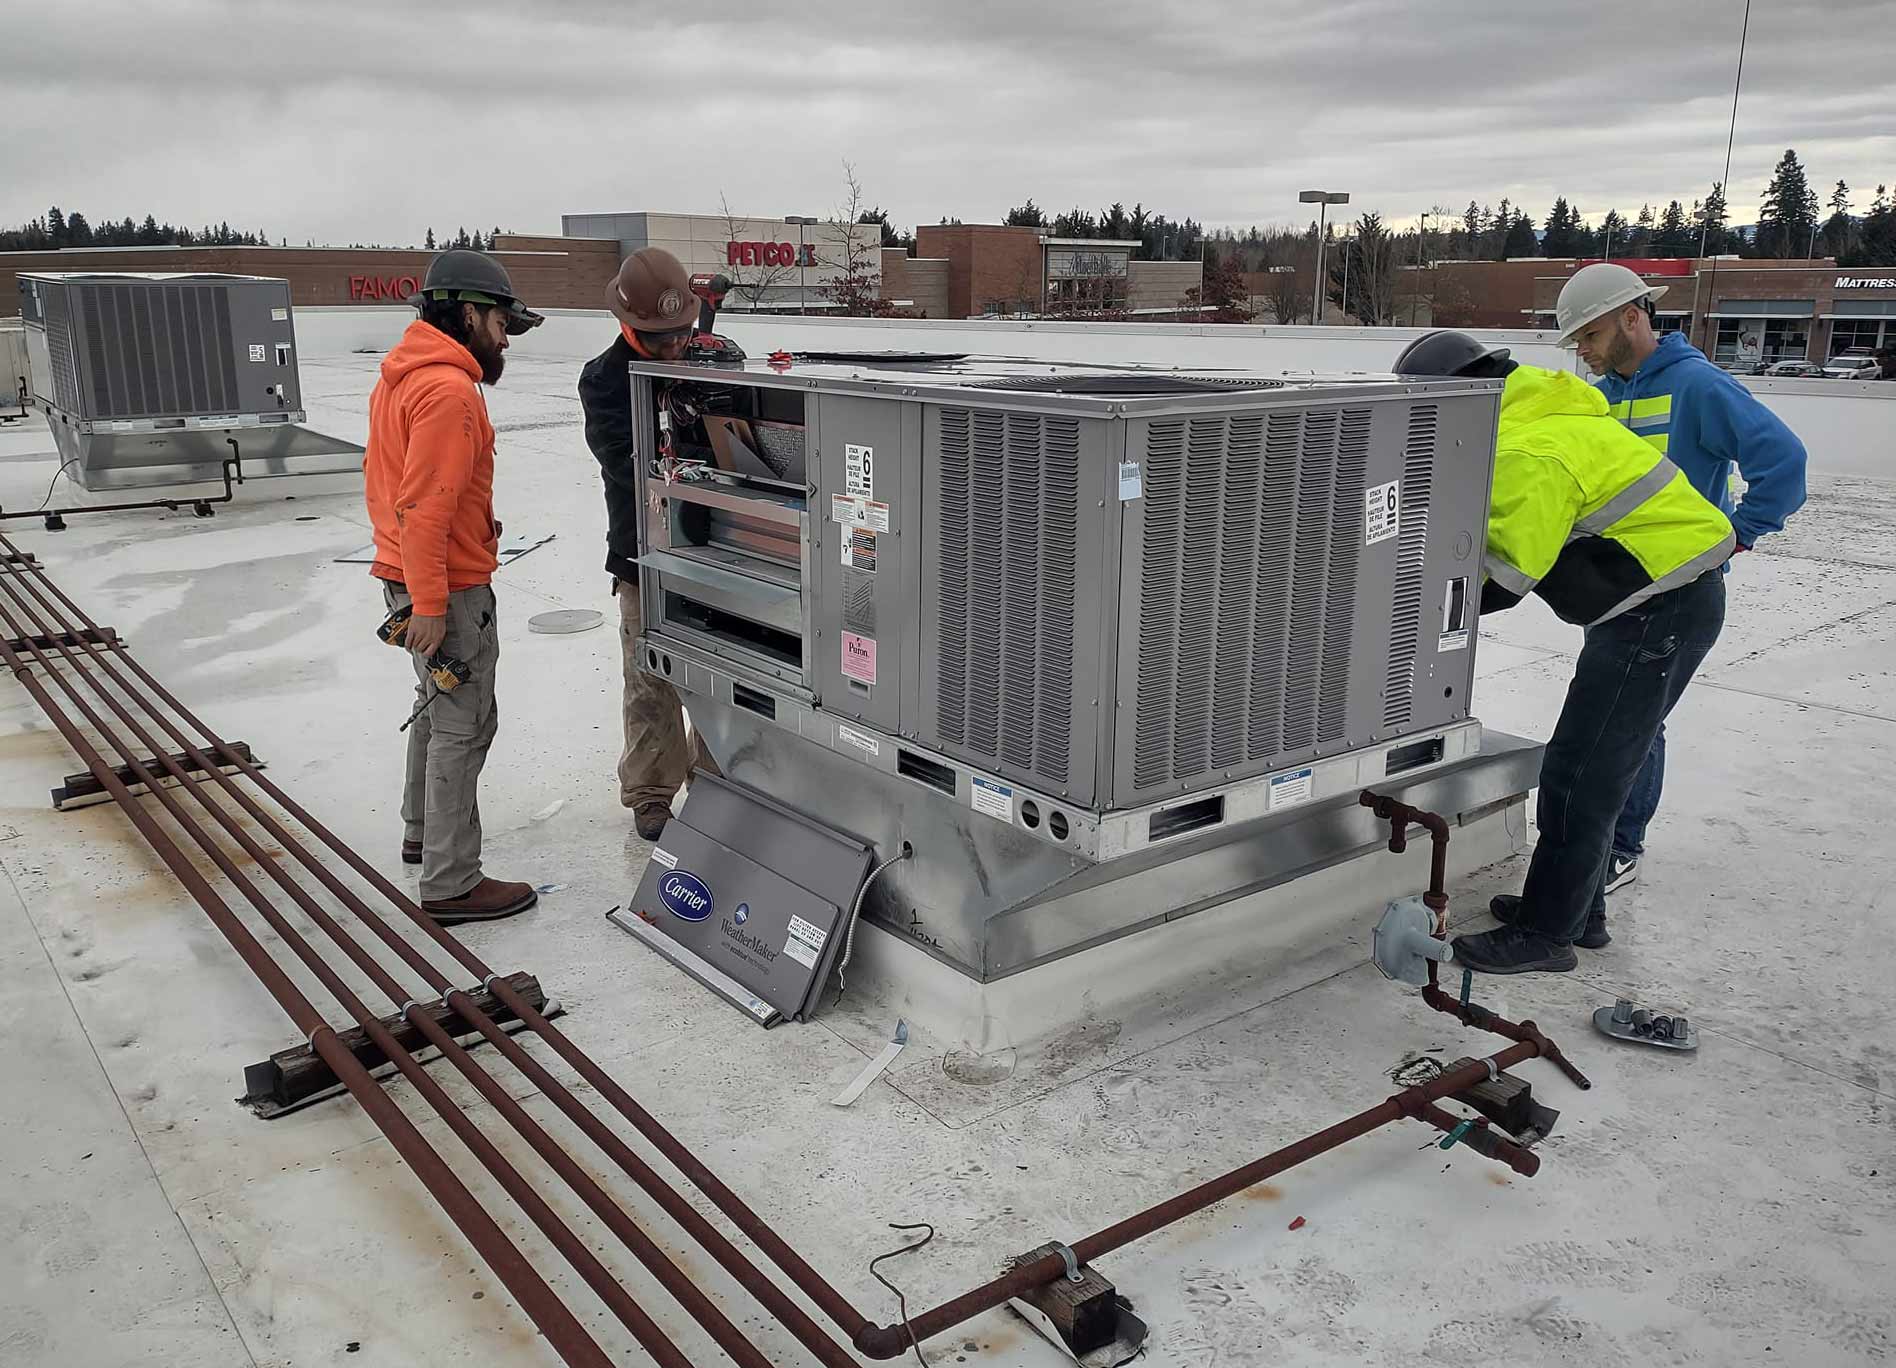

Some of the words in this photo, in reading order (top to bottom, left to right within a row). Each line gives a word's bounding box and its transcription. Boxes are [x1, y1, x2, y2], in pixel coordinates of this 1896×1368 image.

[727, 241, 795, 267] PETCO
[1834, 277, 1896, 288] MATTRES
[863, 450, 870, 475] 6
[1387, 486, 1395, 511] 6
[665, 877, 707, 911] Carrier
